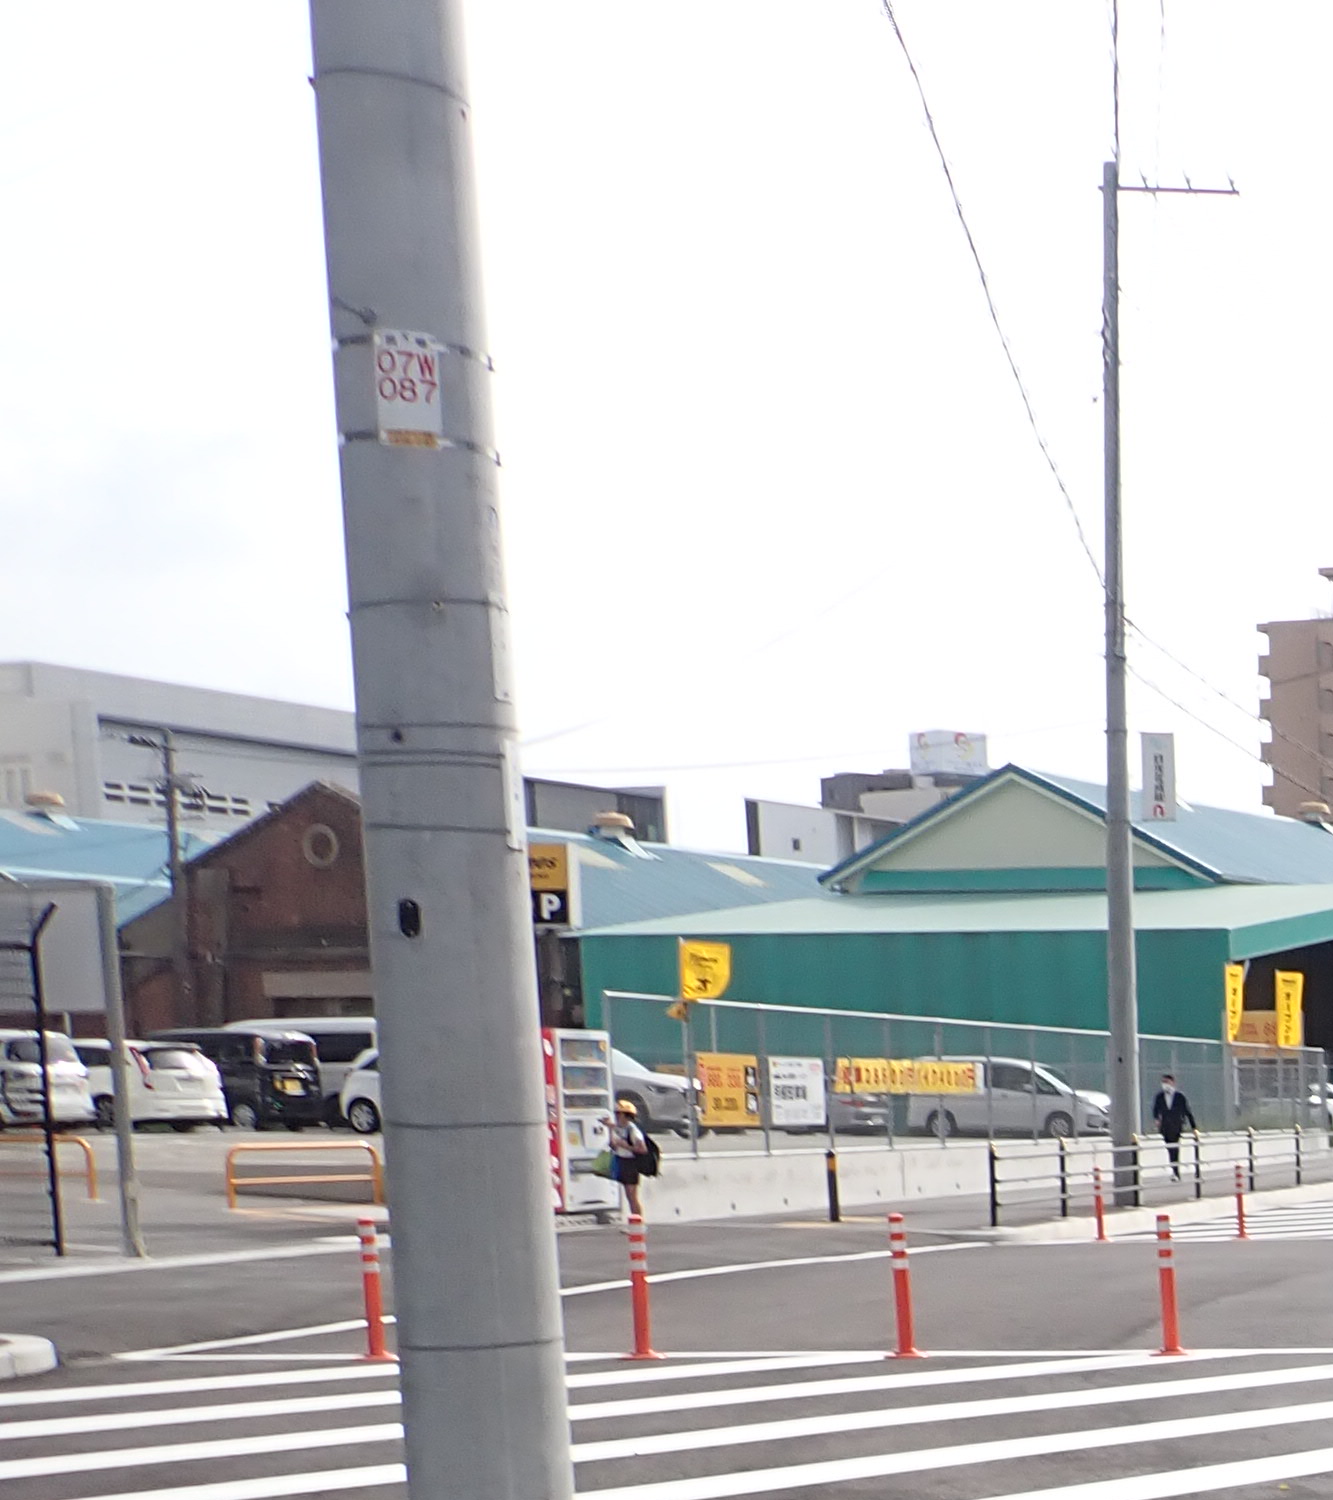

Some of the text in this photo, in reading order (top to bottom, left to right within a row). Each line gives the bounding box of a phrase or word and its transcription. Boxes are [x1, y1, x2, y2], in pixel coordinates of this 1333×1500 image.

[377, 350, 435, 378] 07W
[379, 376, 437, 404] 087
[540, 892, 561, 920] P
